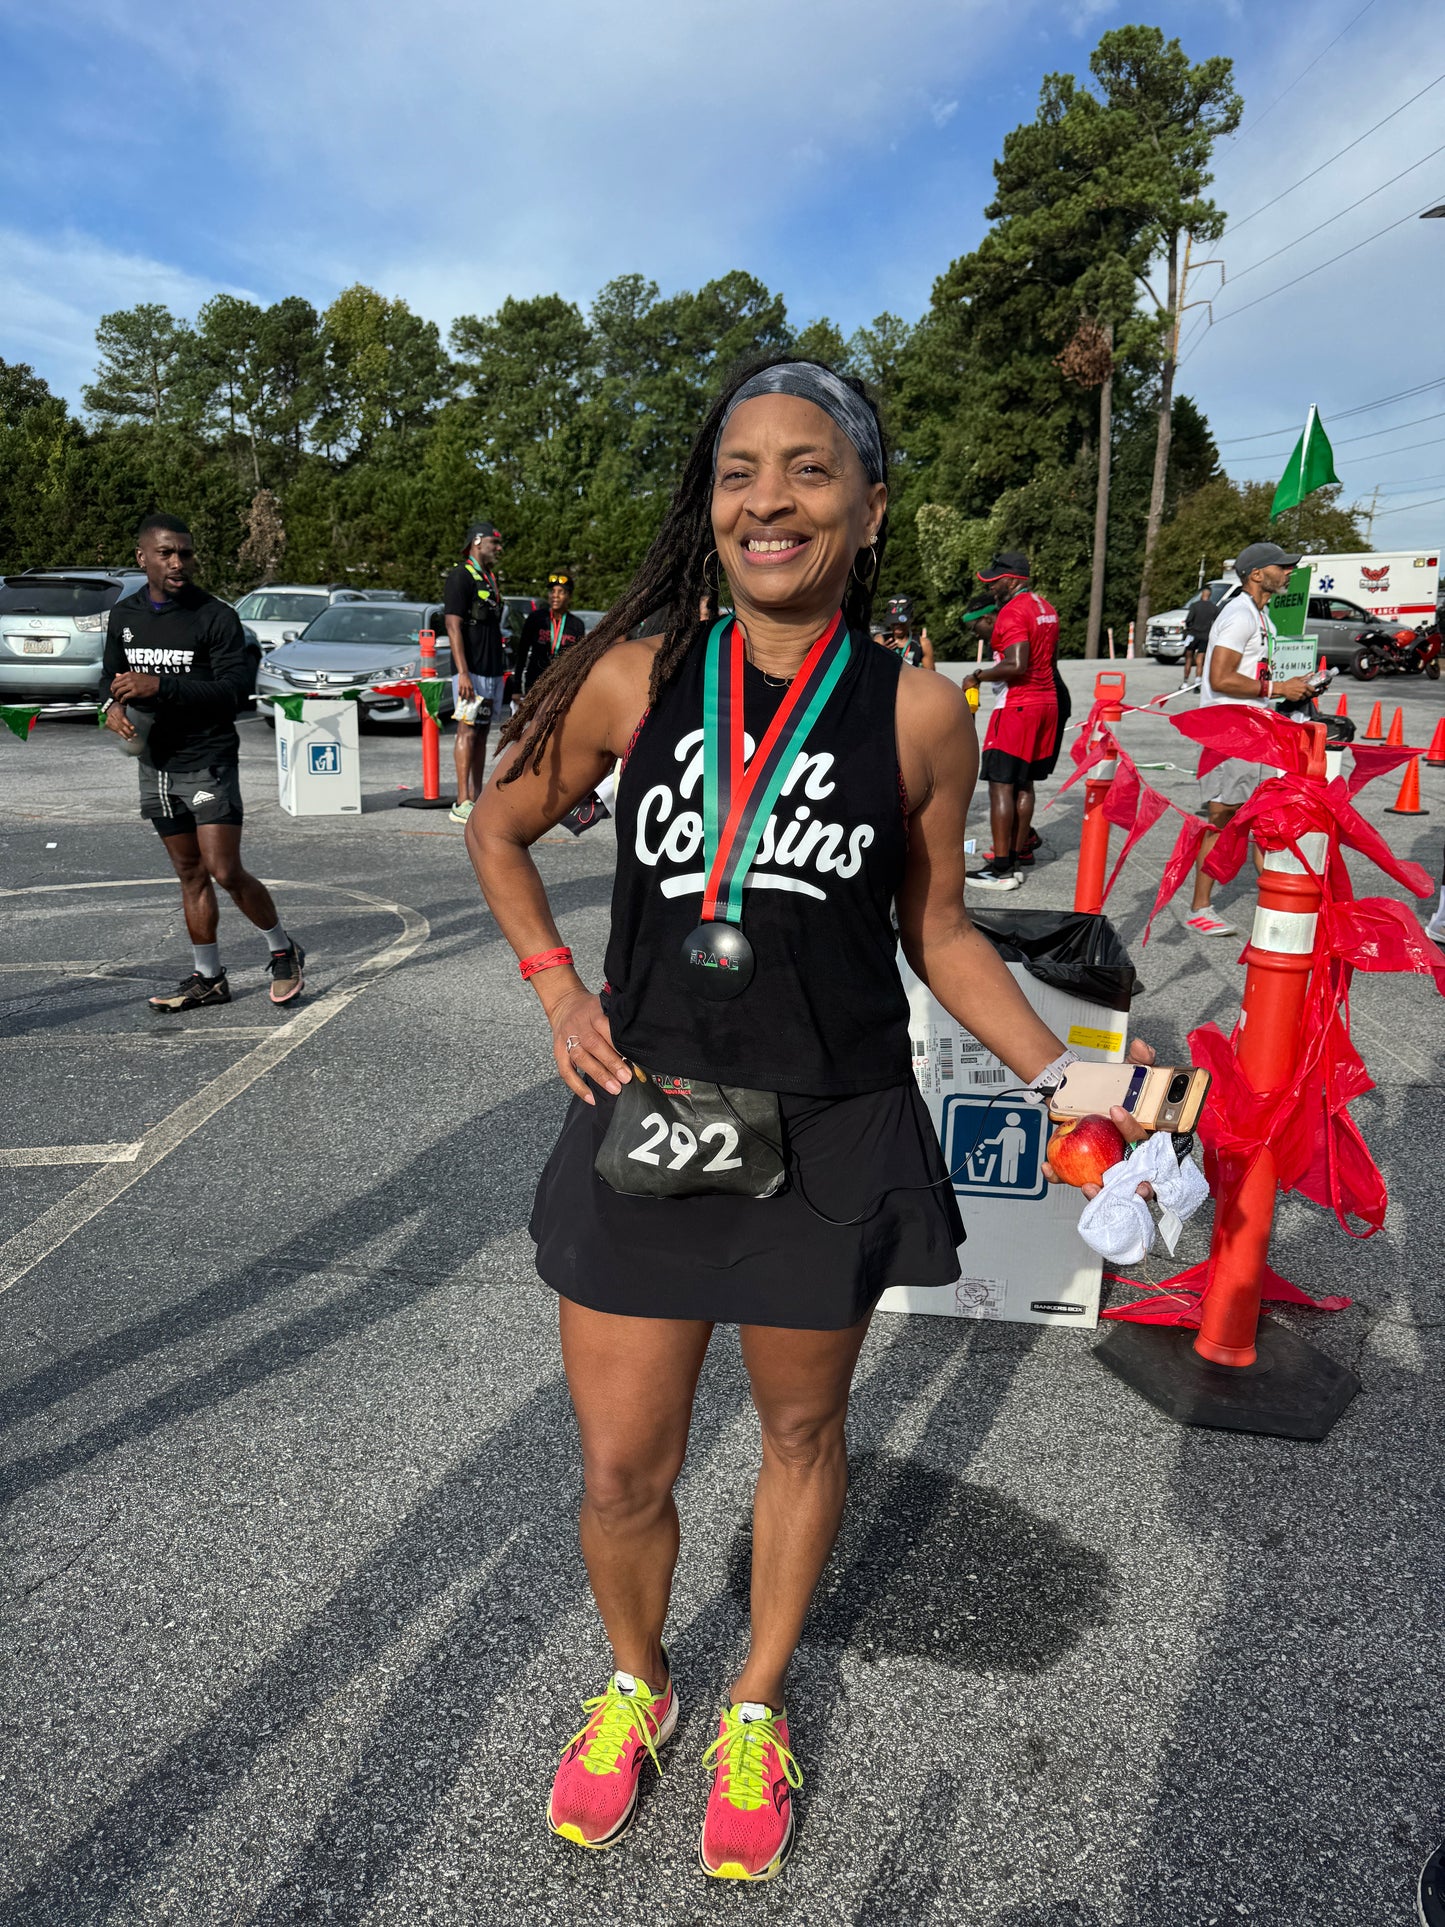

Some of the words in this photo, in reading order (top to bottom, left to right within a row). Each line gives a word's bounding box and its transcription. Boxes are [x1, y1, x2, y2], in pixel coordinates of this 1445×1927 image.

[1274, 593, 1304, 608] GREEN
[154, 666, 191, 674] CLUB
[1280, 662, 1312, 670] 46MINS
[674, 728, 835, 800] Rn
[635, 784, 874, 879] Cosins
[697, 950, 740, 971] RACE
[656, 1074, 691, 1089] RACE
[628, 1112, 742, 1172] 292
